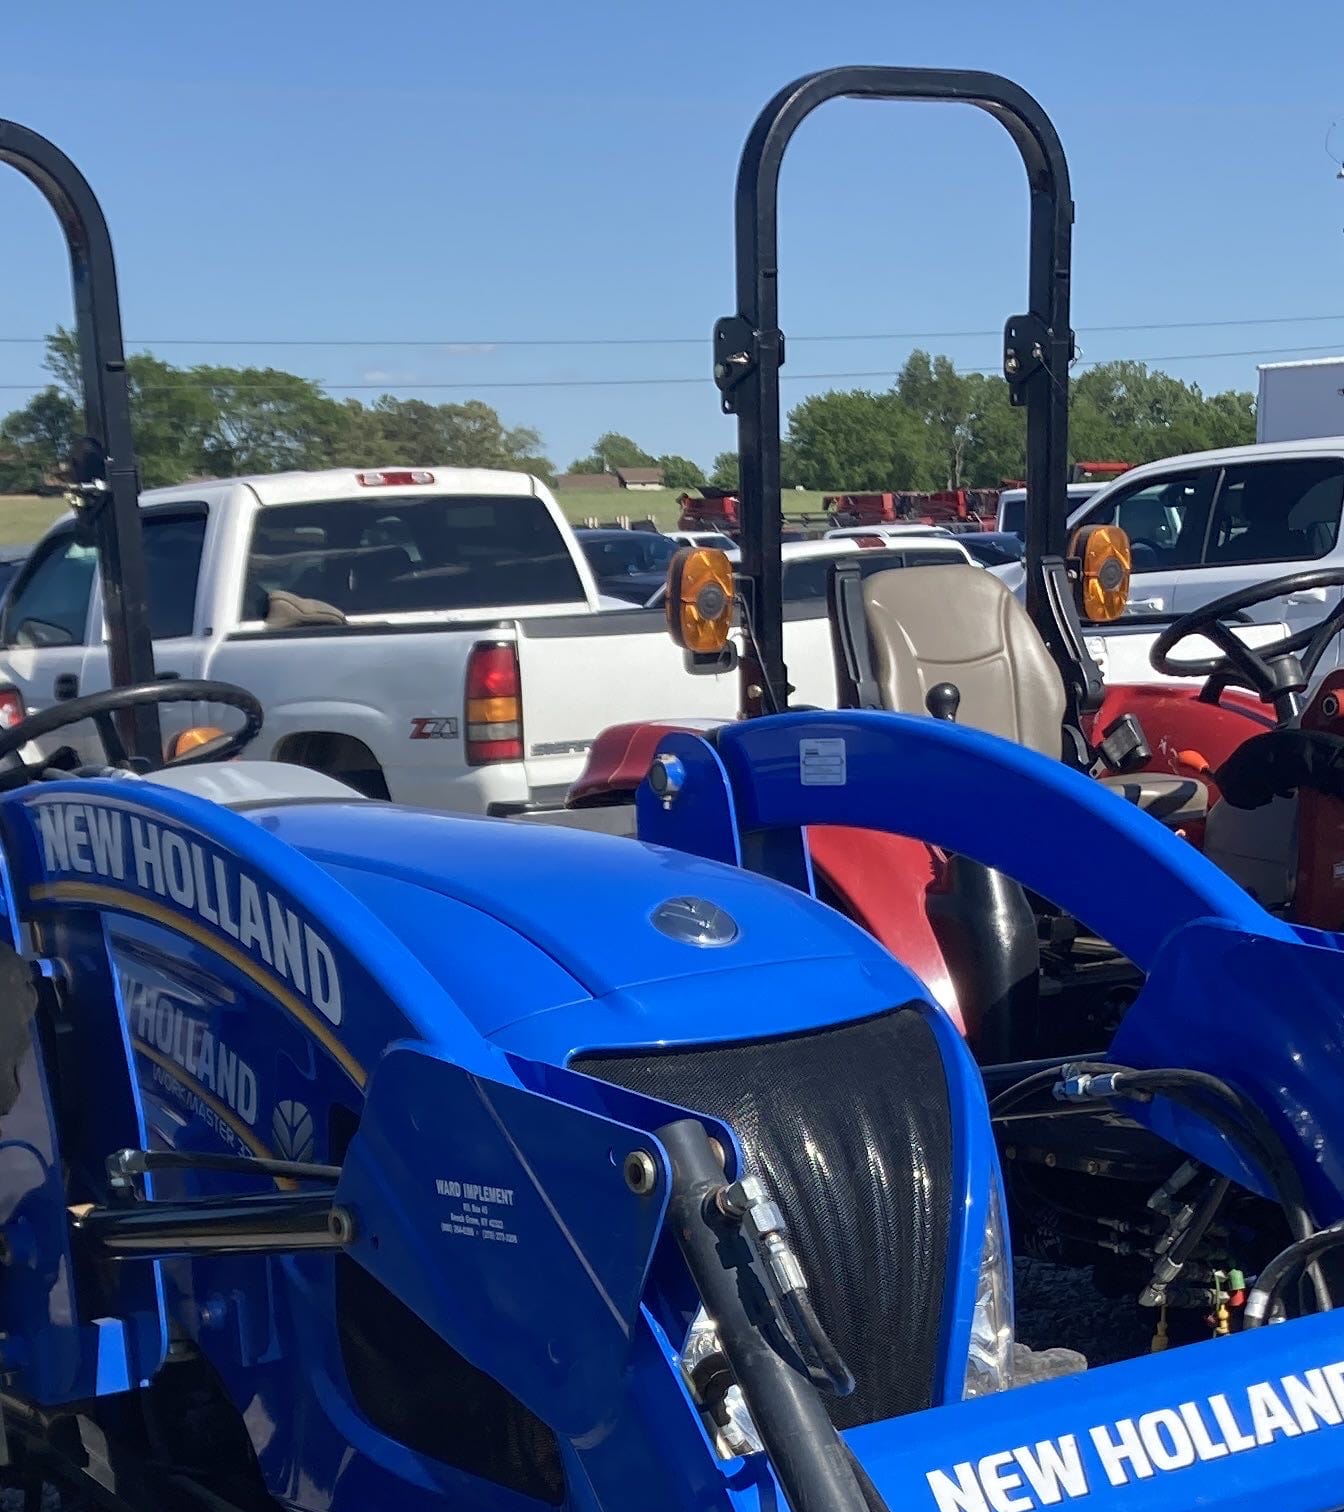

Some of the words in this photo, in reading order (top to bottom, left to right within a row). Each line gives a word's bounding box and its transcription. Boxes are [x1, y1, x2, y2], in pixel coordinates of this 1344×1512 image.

[37, 803, 125, 880] NEW
[128, 814, 344, 1026] HOLLAND
[137, 988, 258, 1127] HOLLAND
[152, 1063, 238, 1146] WORKMASTER
[435, 1179, 462, 1198] WARD
[462, 1182, 515, 1206] IMPLEMENT
